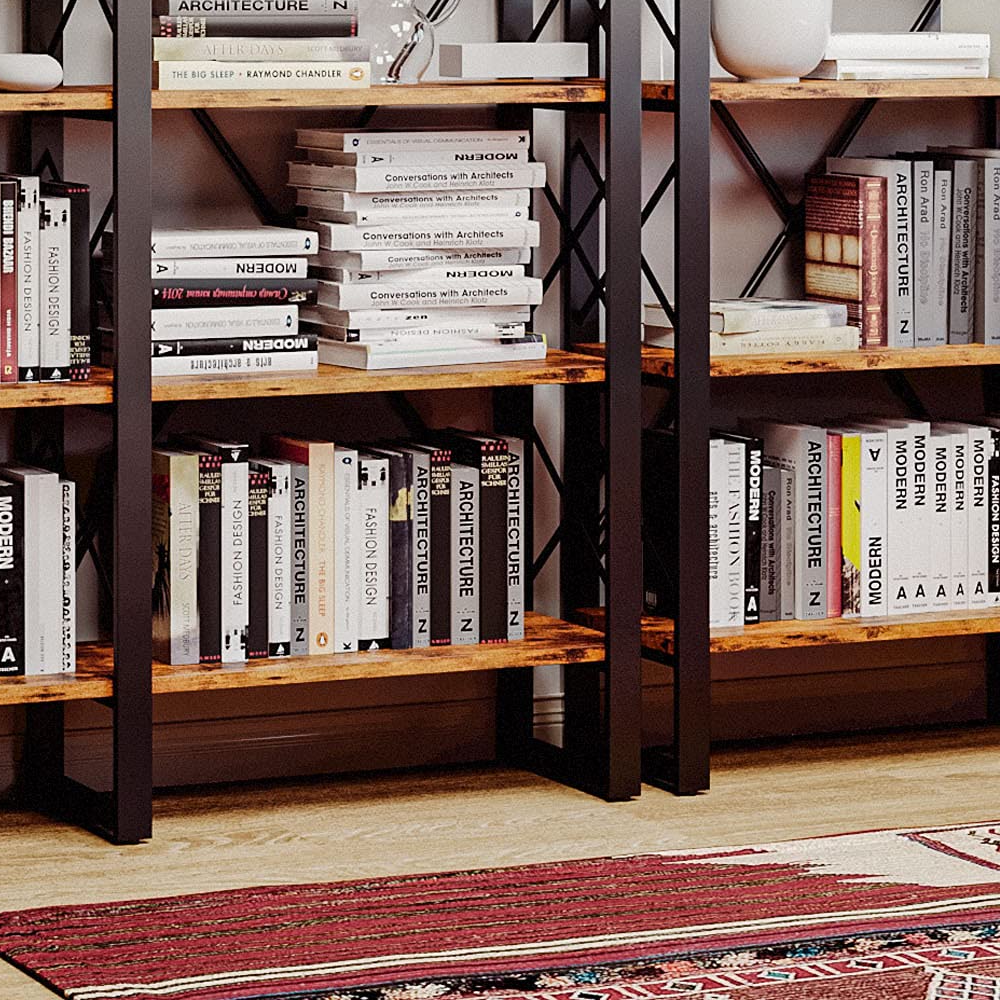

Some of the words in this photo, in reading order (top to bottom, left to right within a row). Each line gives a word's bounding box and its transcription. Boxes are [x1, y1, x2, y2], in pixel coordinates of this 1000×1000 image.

[179, 0, 308, 11] ARCHITECTURE
[333, 1, 348, 9] N
[247, 70, 292, 78] RAYMOND
[296, 70, 341, 78] CHANDLER
[385, 174, 448, 182] Conversations
[920, 170, 929, 193] Ron
[920, 196, 929, 223] Arad
[962, 188, 971, 249] Conversations
[363, 232, 431, 240] Conversations
[897, 173, 909, 297] ARCHITECTURE
[24, 231, 32, 283] FASHION
[49, 247, 59, 293] FASHION
[157, 264, 168, 273] A
[236, 264, 297, 273] MODERN
[961, 271, 969, 313] Architects
[49, 297, 59, 336] DESIGN
[900, 320, 908, 334] N
[158, 344, 173, 354] A
[191, 358, 241, 369] architecture
[243, 339, 308, 350] MODERN
[256, 357, 271, 367] arts
[869, 448, 881, 461] A
[915, 436, 925, 506] MODERN
[974, 440, 984, 507] MODERN
[750, 450, 761, 521] MODERN
[896, 441, 907, 509] MODERN
[936, 448, 946, 513] MODERN
[956, 446, 964, 511] MODERN
[233, 500, 242, 546] DESIGN
[508, 453, 519, 586] ARCHITECTURE
[808, 441, 821, 568] ARCHITECTURE
[275, 516, 283, 564] FASHION
[294, 477, 306, 604] ARCHITECTURE
[366, 508, 377, 559] FASHION
[417, 466, 428, 595] ARCHITECTURE
[459, 481, 474, 597] ARCHITECTURE
[233, 551, 242, 605] FASHION
[275, 568, 283, 610] DESIGN
[366, 563, 377, 605] DESIGN
[869, 537, 882, 605] MODERN
[509, 611, 518, 626] N
[747, 597, 757, 612] A
[809, 592, 820, 606] N
[296, 628, 305, 642] N
[418, 619, 427, 633] N
[461, 619, 472, 632] N
[1, 647, 16, 662] A
